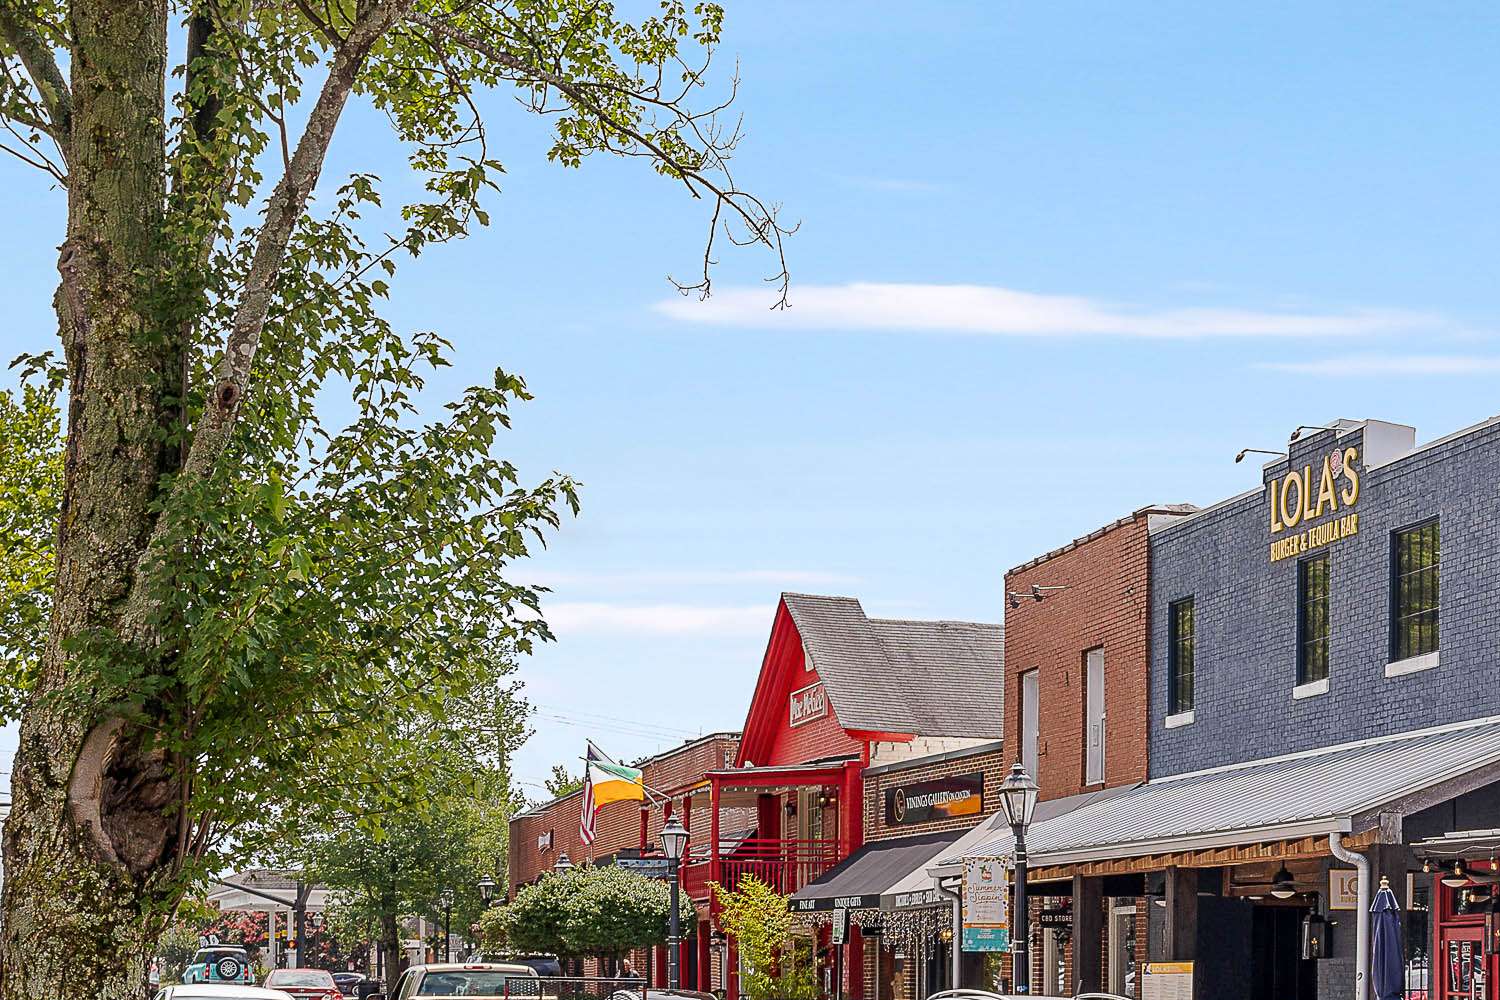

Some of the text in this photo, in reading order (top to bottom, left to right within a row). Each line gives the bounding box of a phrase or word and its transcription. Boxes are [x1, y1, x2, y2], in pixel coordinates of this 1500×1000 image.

[1270, 513, 1359, 562] BURGER & TEQUILA BAR
[906, 794, 928, 809] VININGS
[928, 791, 950, 806] GALLERY
[968, 882, 1002, 893] Summer
[799, 900, 808, 910] FINE
[834, 896, 862, 909] UNIQUE GIFTS
[1041, 914, 1073, 922] CBD STORE
